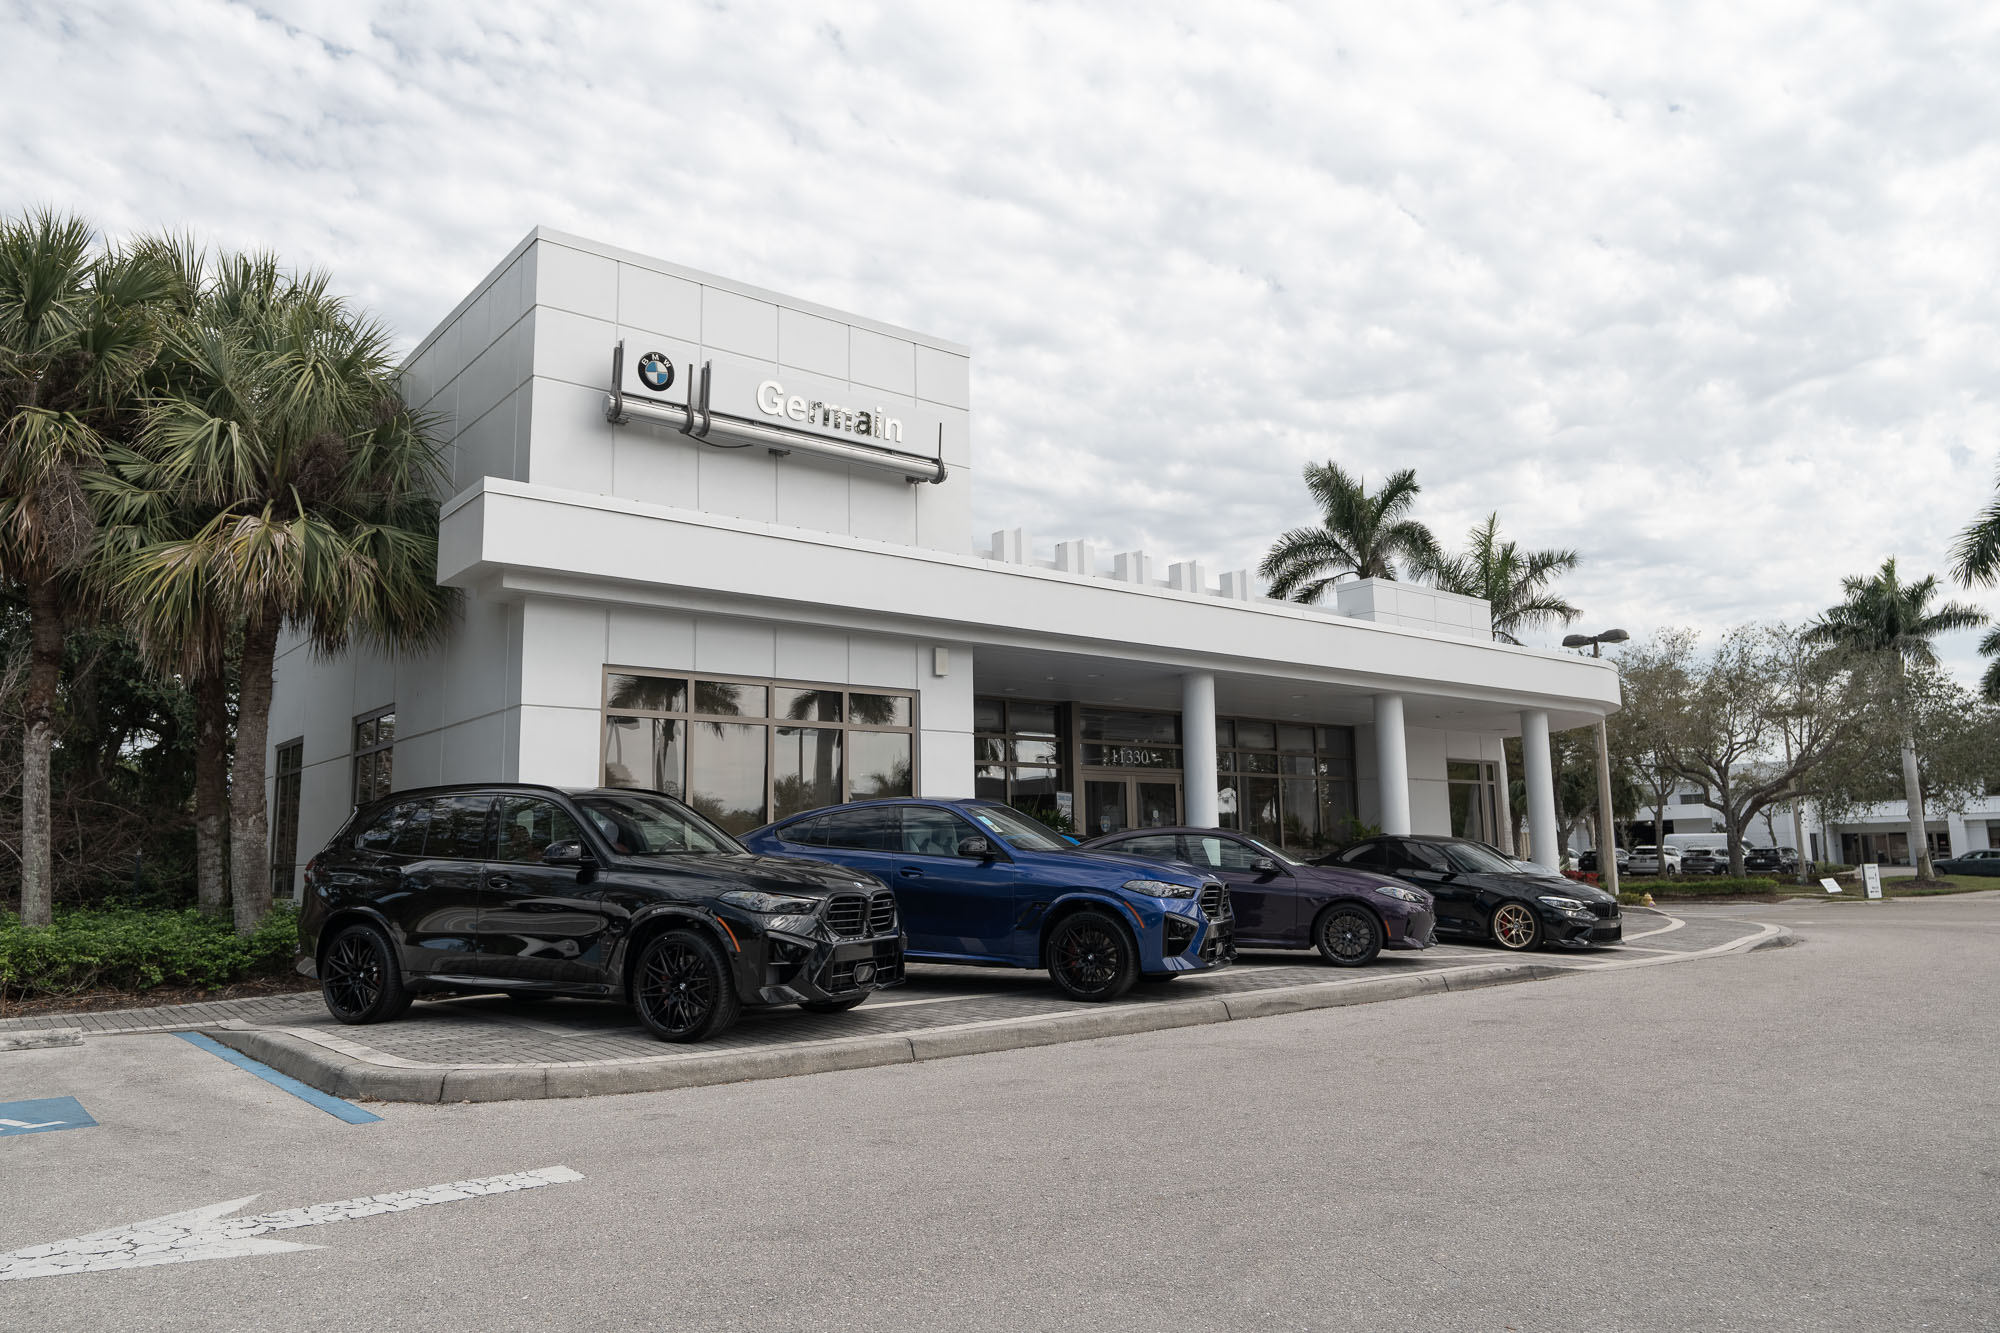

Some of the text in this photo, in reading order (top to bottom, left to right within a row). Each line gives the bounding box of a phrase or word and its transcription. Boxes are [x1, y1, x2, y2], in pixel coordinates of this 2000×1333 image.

[641, 354, 671, 368] BMW
[756, 380, 903, 443] Germain
[1112, 749, 1150, 764] 11330
